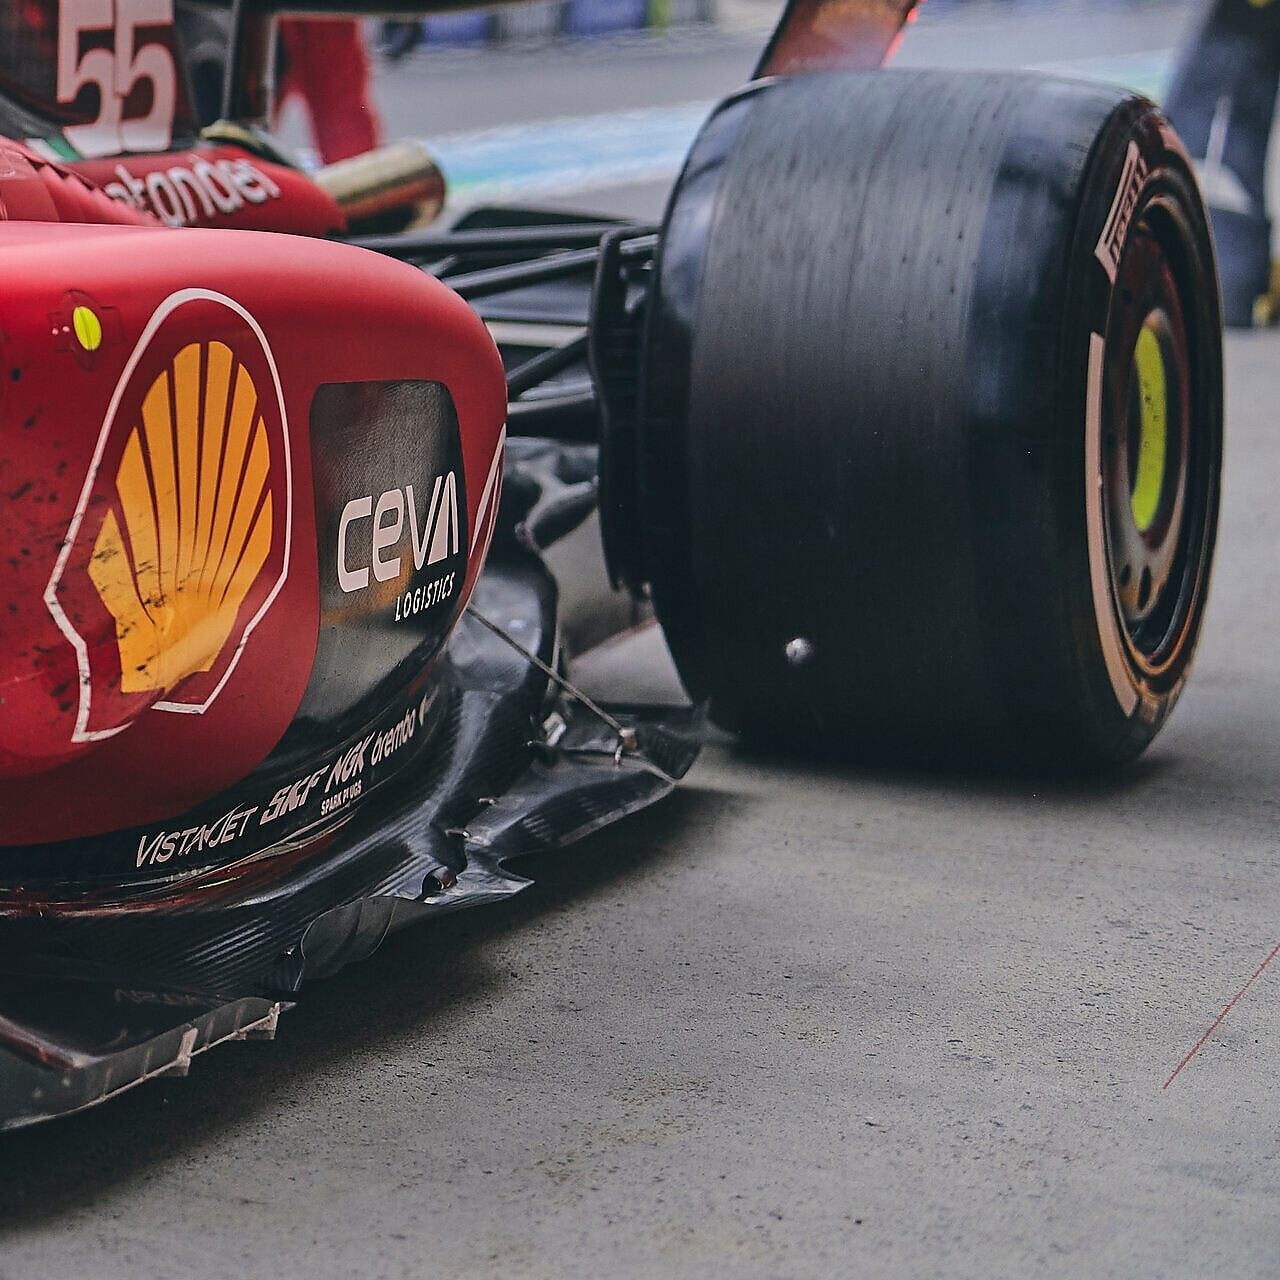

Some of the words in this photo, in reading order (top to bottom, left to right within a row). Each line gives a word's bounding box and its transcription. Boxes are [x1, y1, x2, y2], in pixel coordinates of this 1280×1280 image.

[395, 572, 456, 622] LOGISTICS
[136, 802, 259, 868] VISTAJET
[260, 765, 330, 825] SKF
[325, 731, 375, 793] NGK
[370, 708, 417, 766] brembo
[321, 791, 342, 816] SPARK
